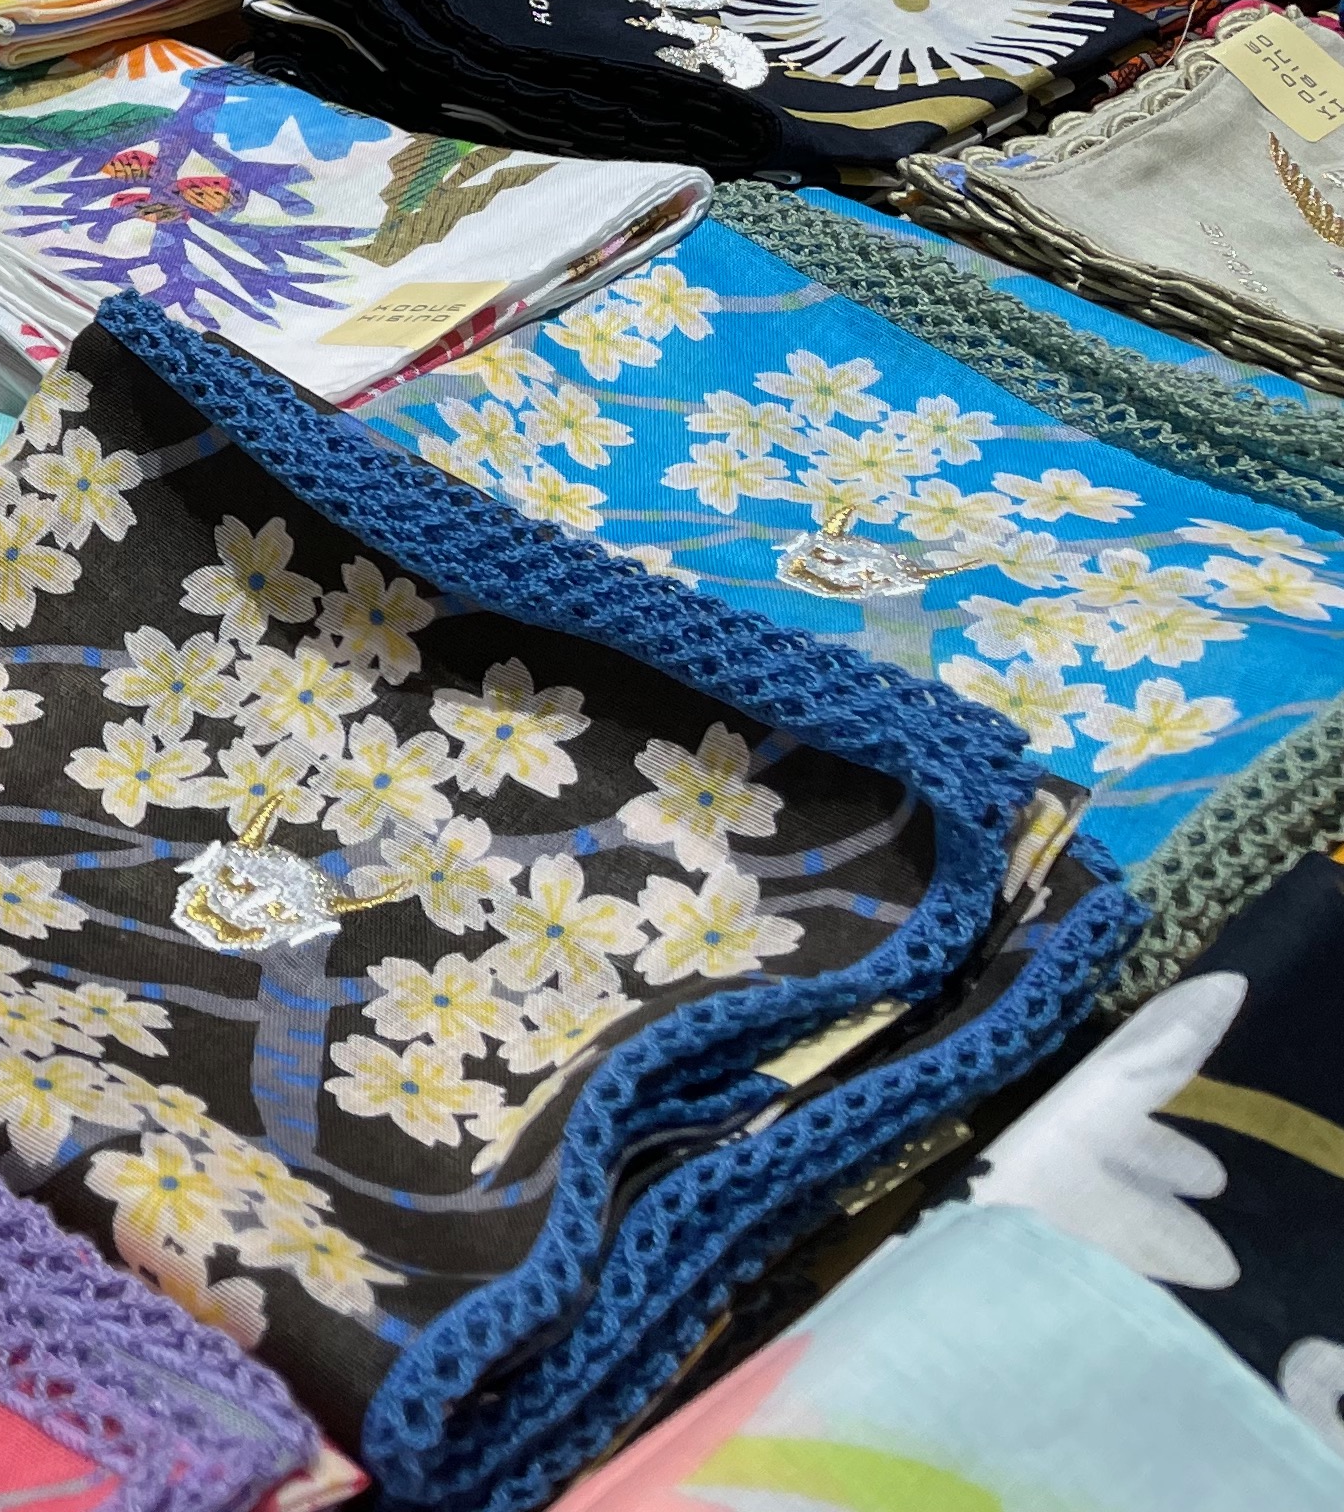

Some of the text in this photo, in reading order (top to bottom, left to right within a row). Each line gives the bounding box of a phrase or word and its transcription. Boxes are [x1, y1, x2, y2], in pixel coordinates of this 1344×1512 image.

[1244, 40, 1337, 120] KODUE
[1256, 34, 1344, 114] HIBINO
[356, 314, 452, 323] HIBINO
[372, 303, 467, 313] KODUE
